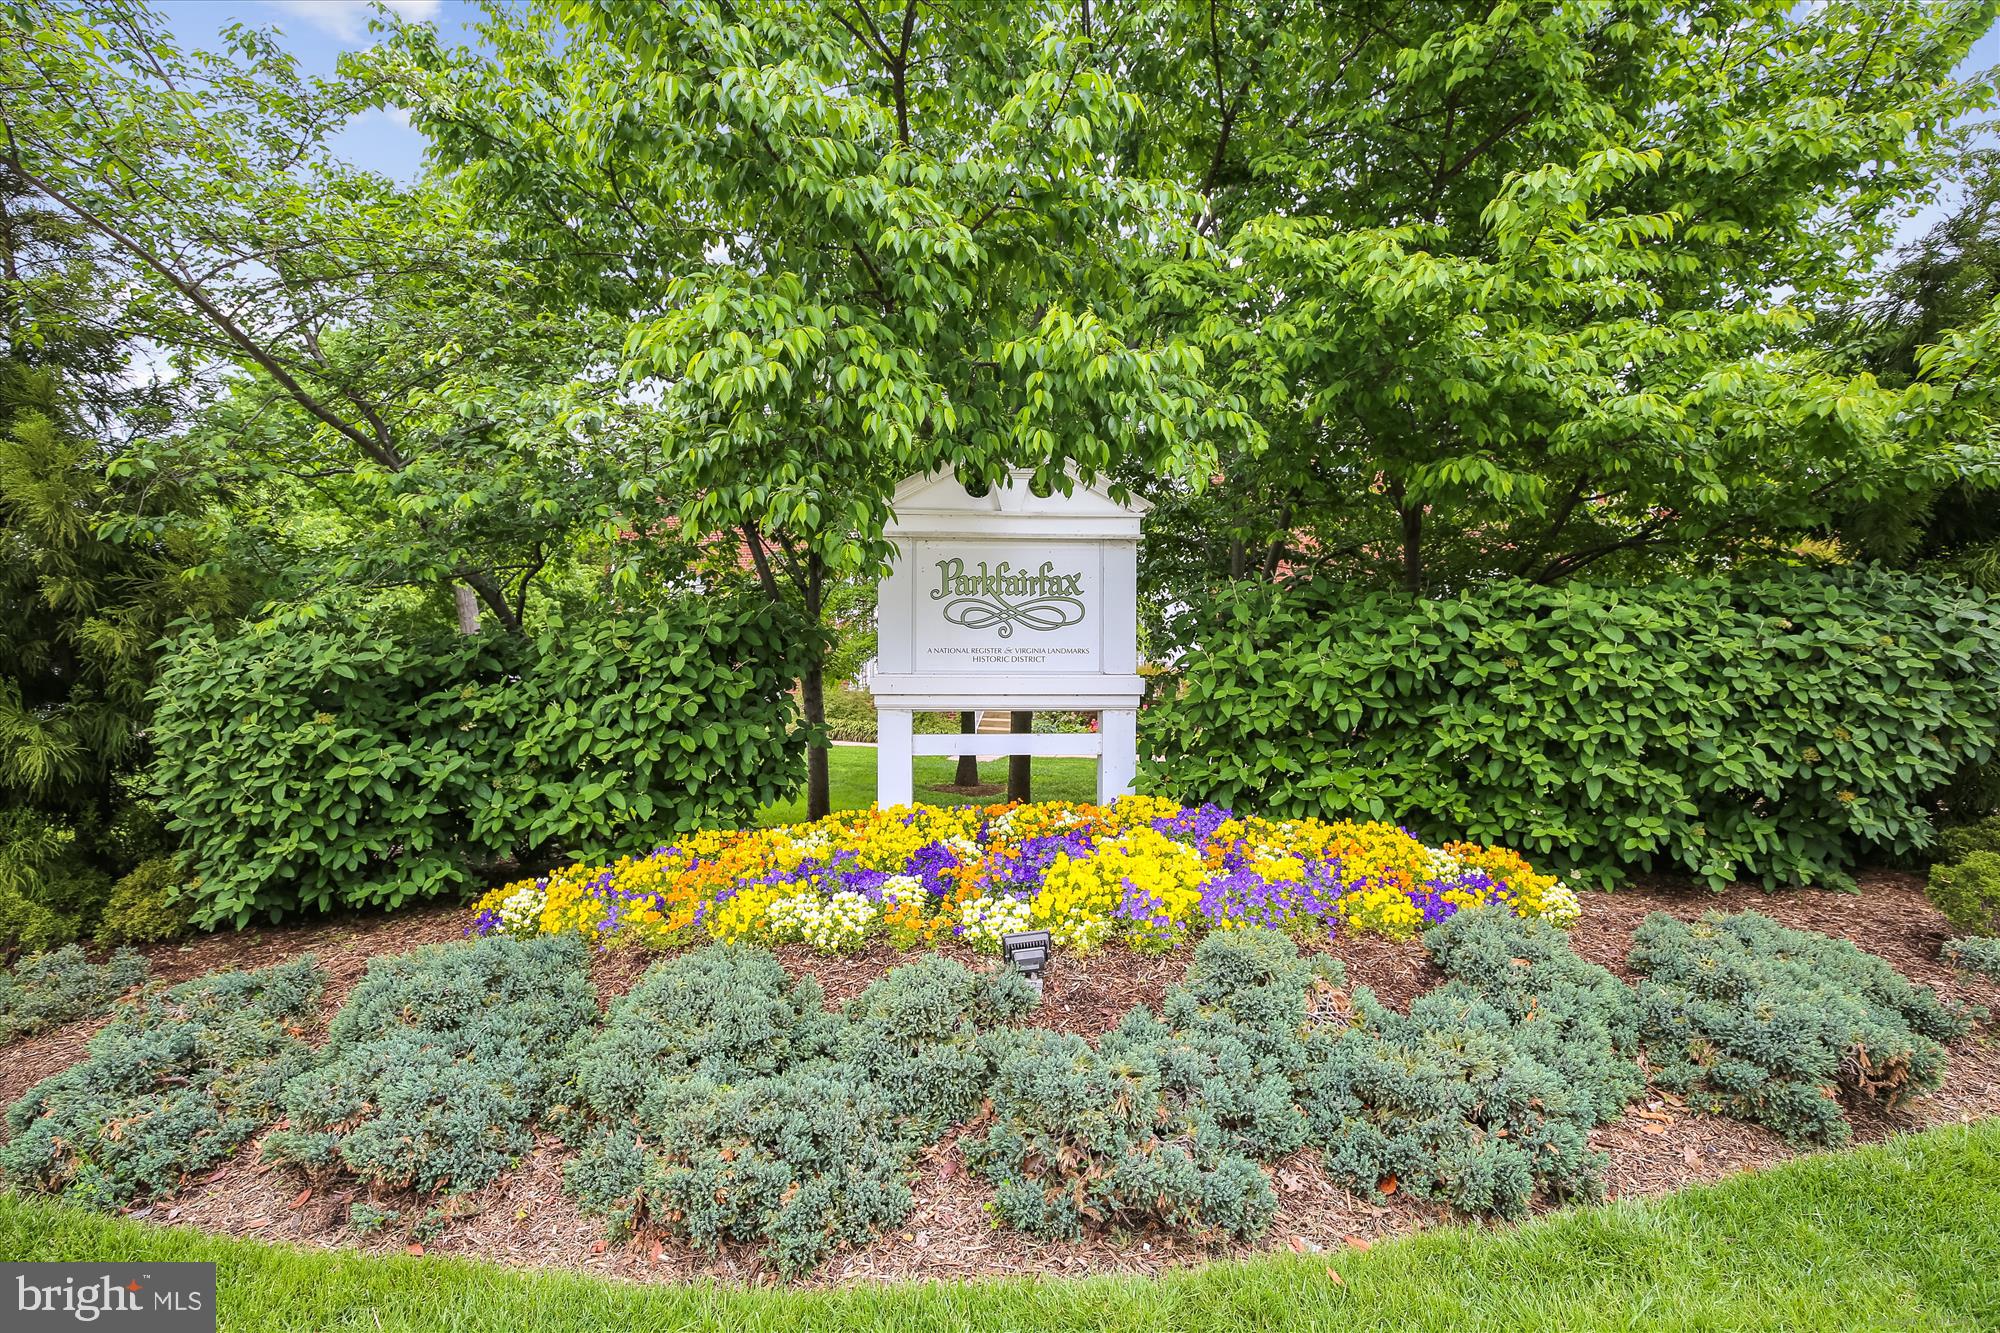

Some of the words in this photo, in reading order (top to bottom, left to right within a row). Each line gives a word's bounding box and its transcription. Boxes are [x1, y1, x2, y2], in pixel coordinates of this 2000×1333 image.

[929, 556, 1085, 602] Parkfairfax
[927, 647, 933, 655] A
[933, 647, 970, 655] NATIONAL
[970, 647, 1002, 655] REGISTER
[1003, 646, 1013, 655] &
[1014, 647, 1046, 655] VIRGINIA
[1047, 647, 1090, 655] LANDMARKS
[972, 655, 1010, 663] HISTORIC
[1011, 655, 1046, 663] DISTRICT
